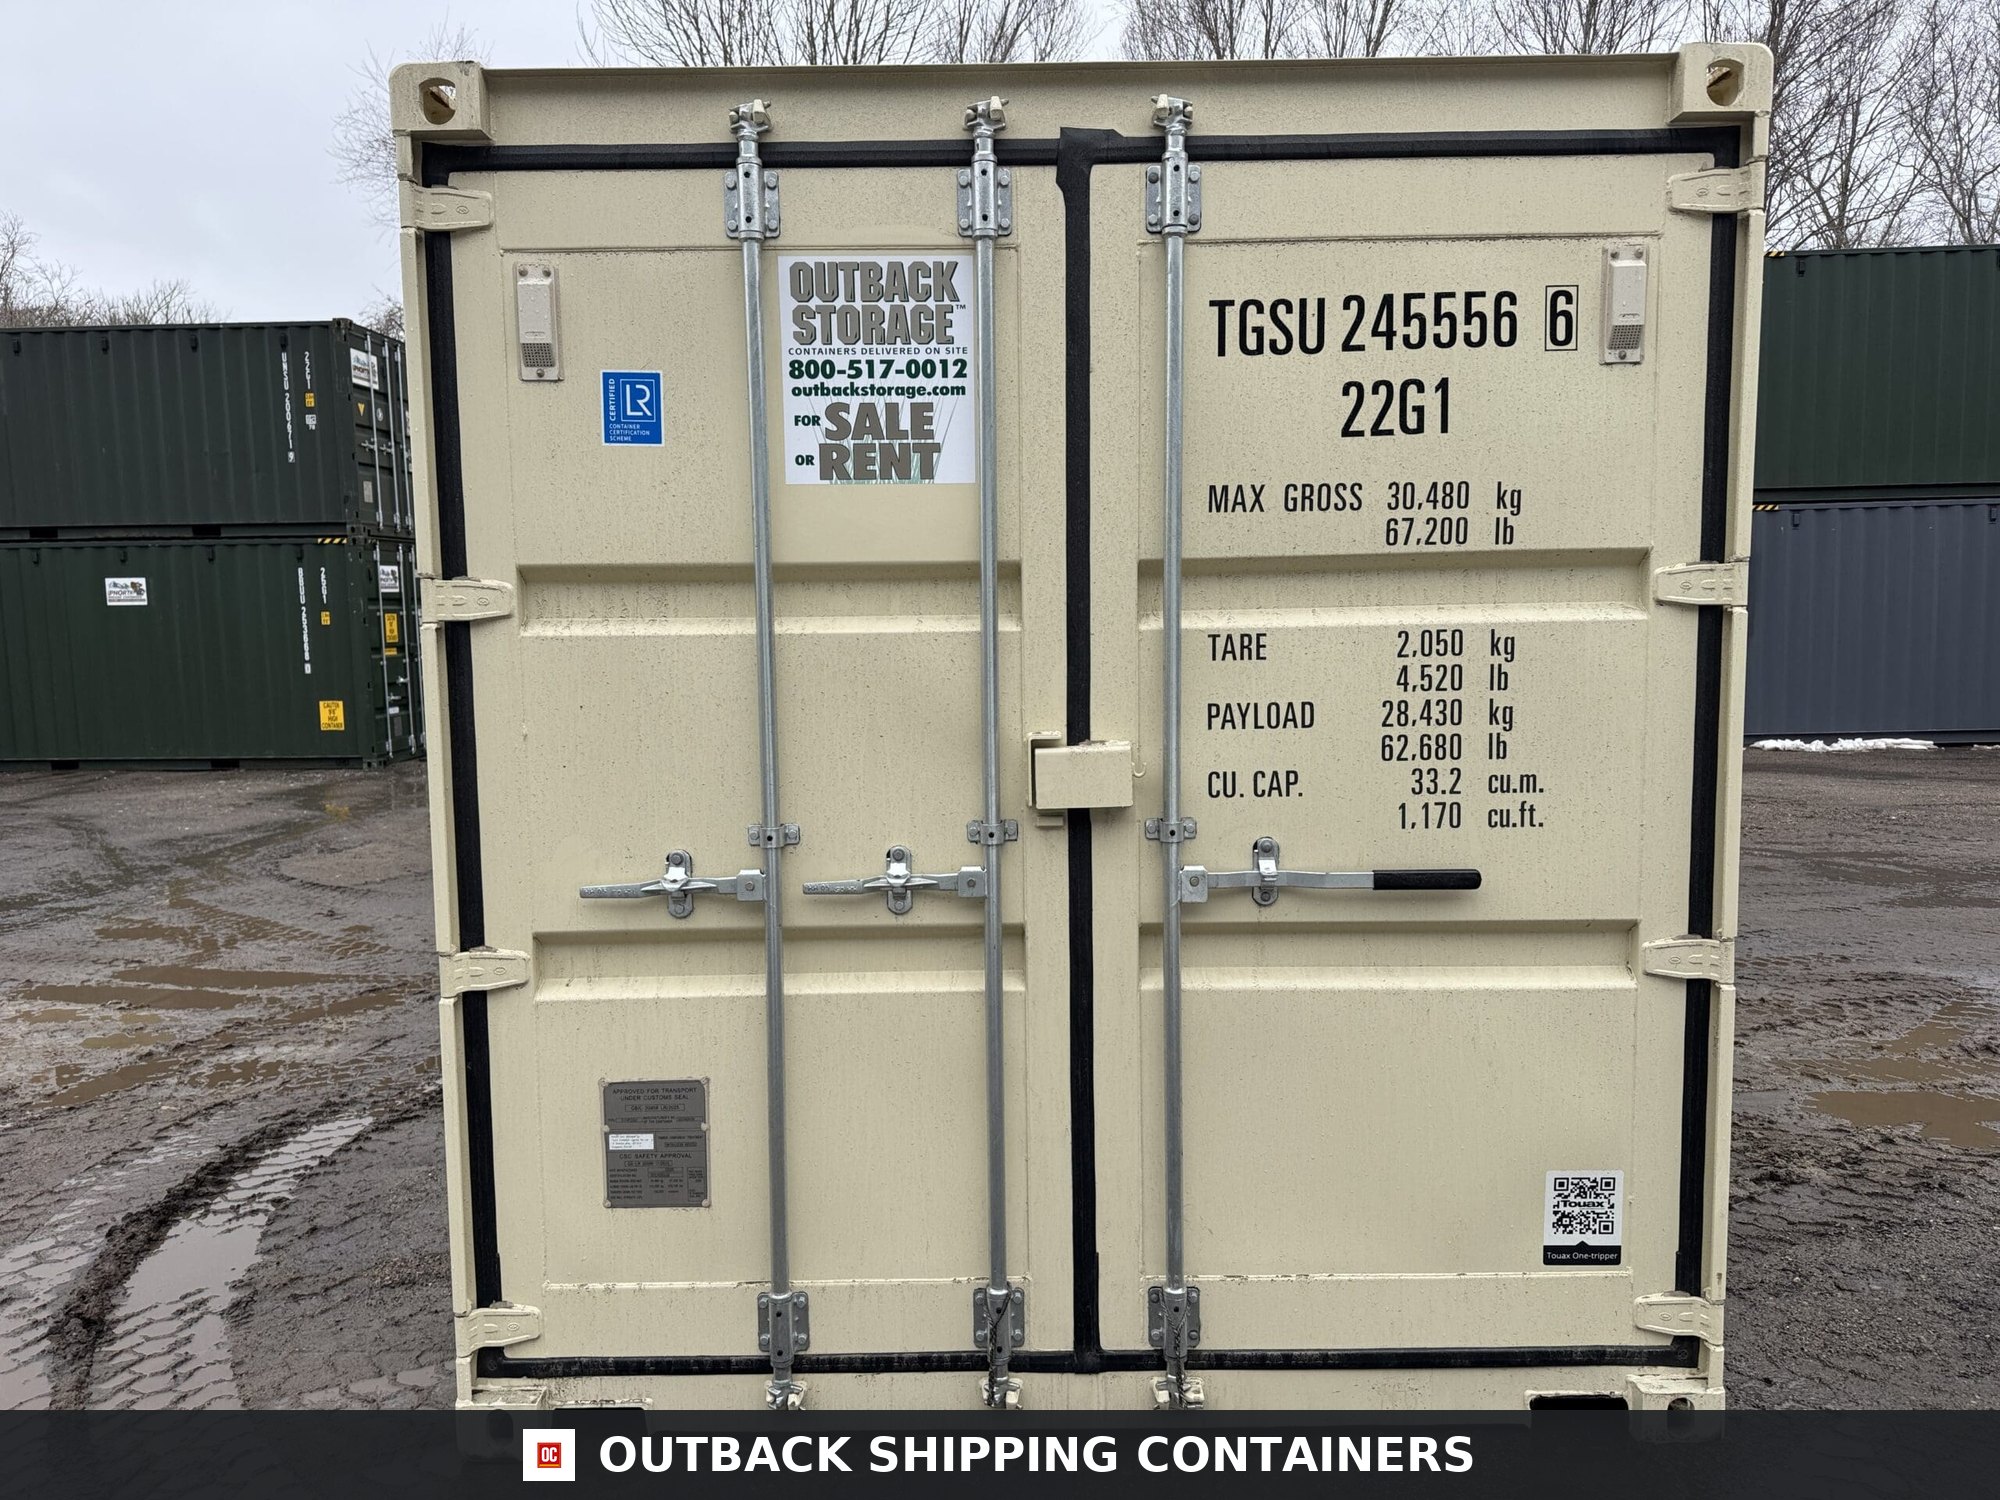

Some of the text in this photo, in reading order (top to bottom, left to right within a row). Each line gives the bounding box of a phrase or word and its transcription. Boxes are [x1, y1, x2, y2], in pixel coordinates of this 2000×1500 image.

[789, 261, 961, 303] OUTBACK
[792, 304, 954, 346] STORAGE
[1209, 289, 1574, 357] TGSU 245556 6
[788, 346, 968, 356] CONTAINERS DELIVERED ON SITE
[788, 358, 968, 379] 800-517-0012
[625, 384, 653, 416] LR
[791, 381, 966, 399] outbackstorage.com
[794, 401, 935, 442] FOR SALE
[1340, 376, 1450, 438] 22G1
[795, 442, 941, 481] OR RENT
[1208, 481, 1522, 517] MAX GROSS 30,480 kg
[1385, 517, 1514, 546] 67,200 lb
[1207, 629, 1515, 662] TARE 2,050 kg
[1396, 664, 1509, 693] 4,520 lb
[1207, 699, 1514, 732] PAYLOAD 28,430 kg
[1381, 733, 1507, 762] 62,680 lb
[1207, 768, 1544, 799] CU. CAP. 33.2 cu.m.
[1398, 801, 1544, 830] 1,170 cu.ft.
[1560, 1200, 1604, 1208] Touax
[1572, 1252, 1618, 1261] One-tripper
